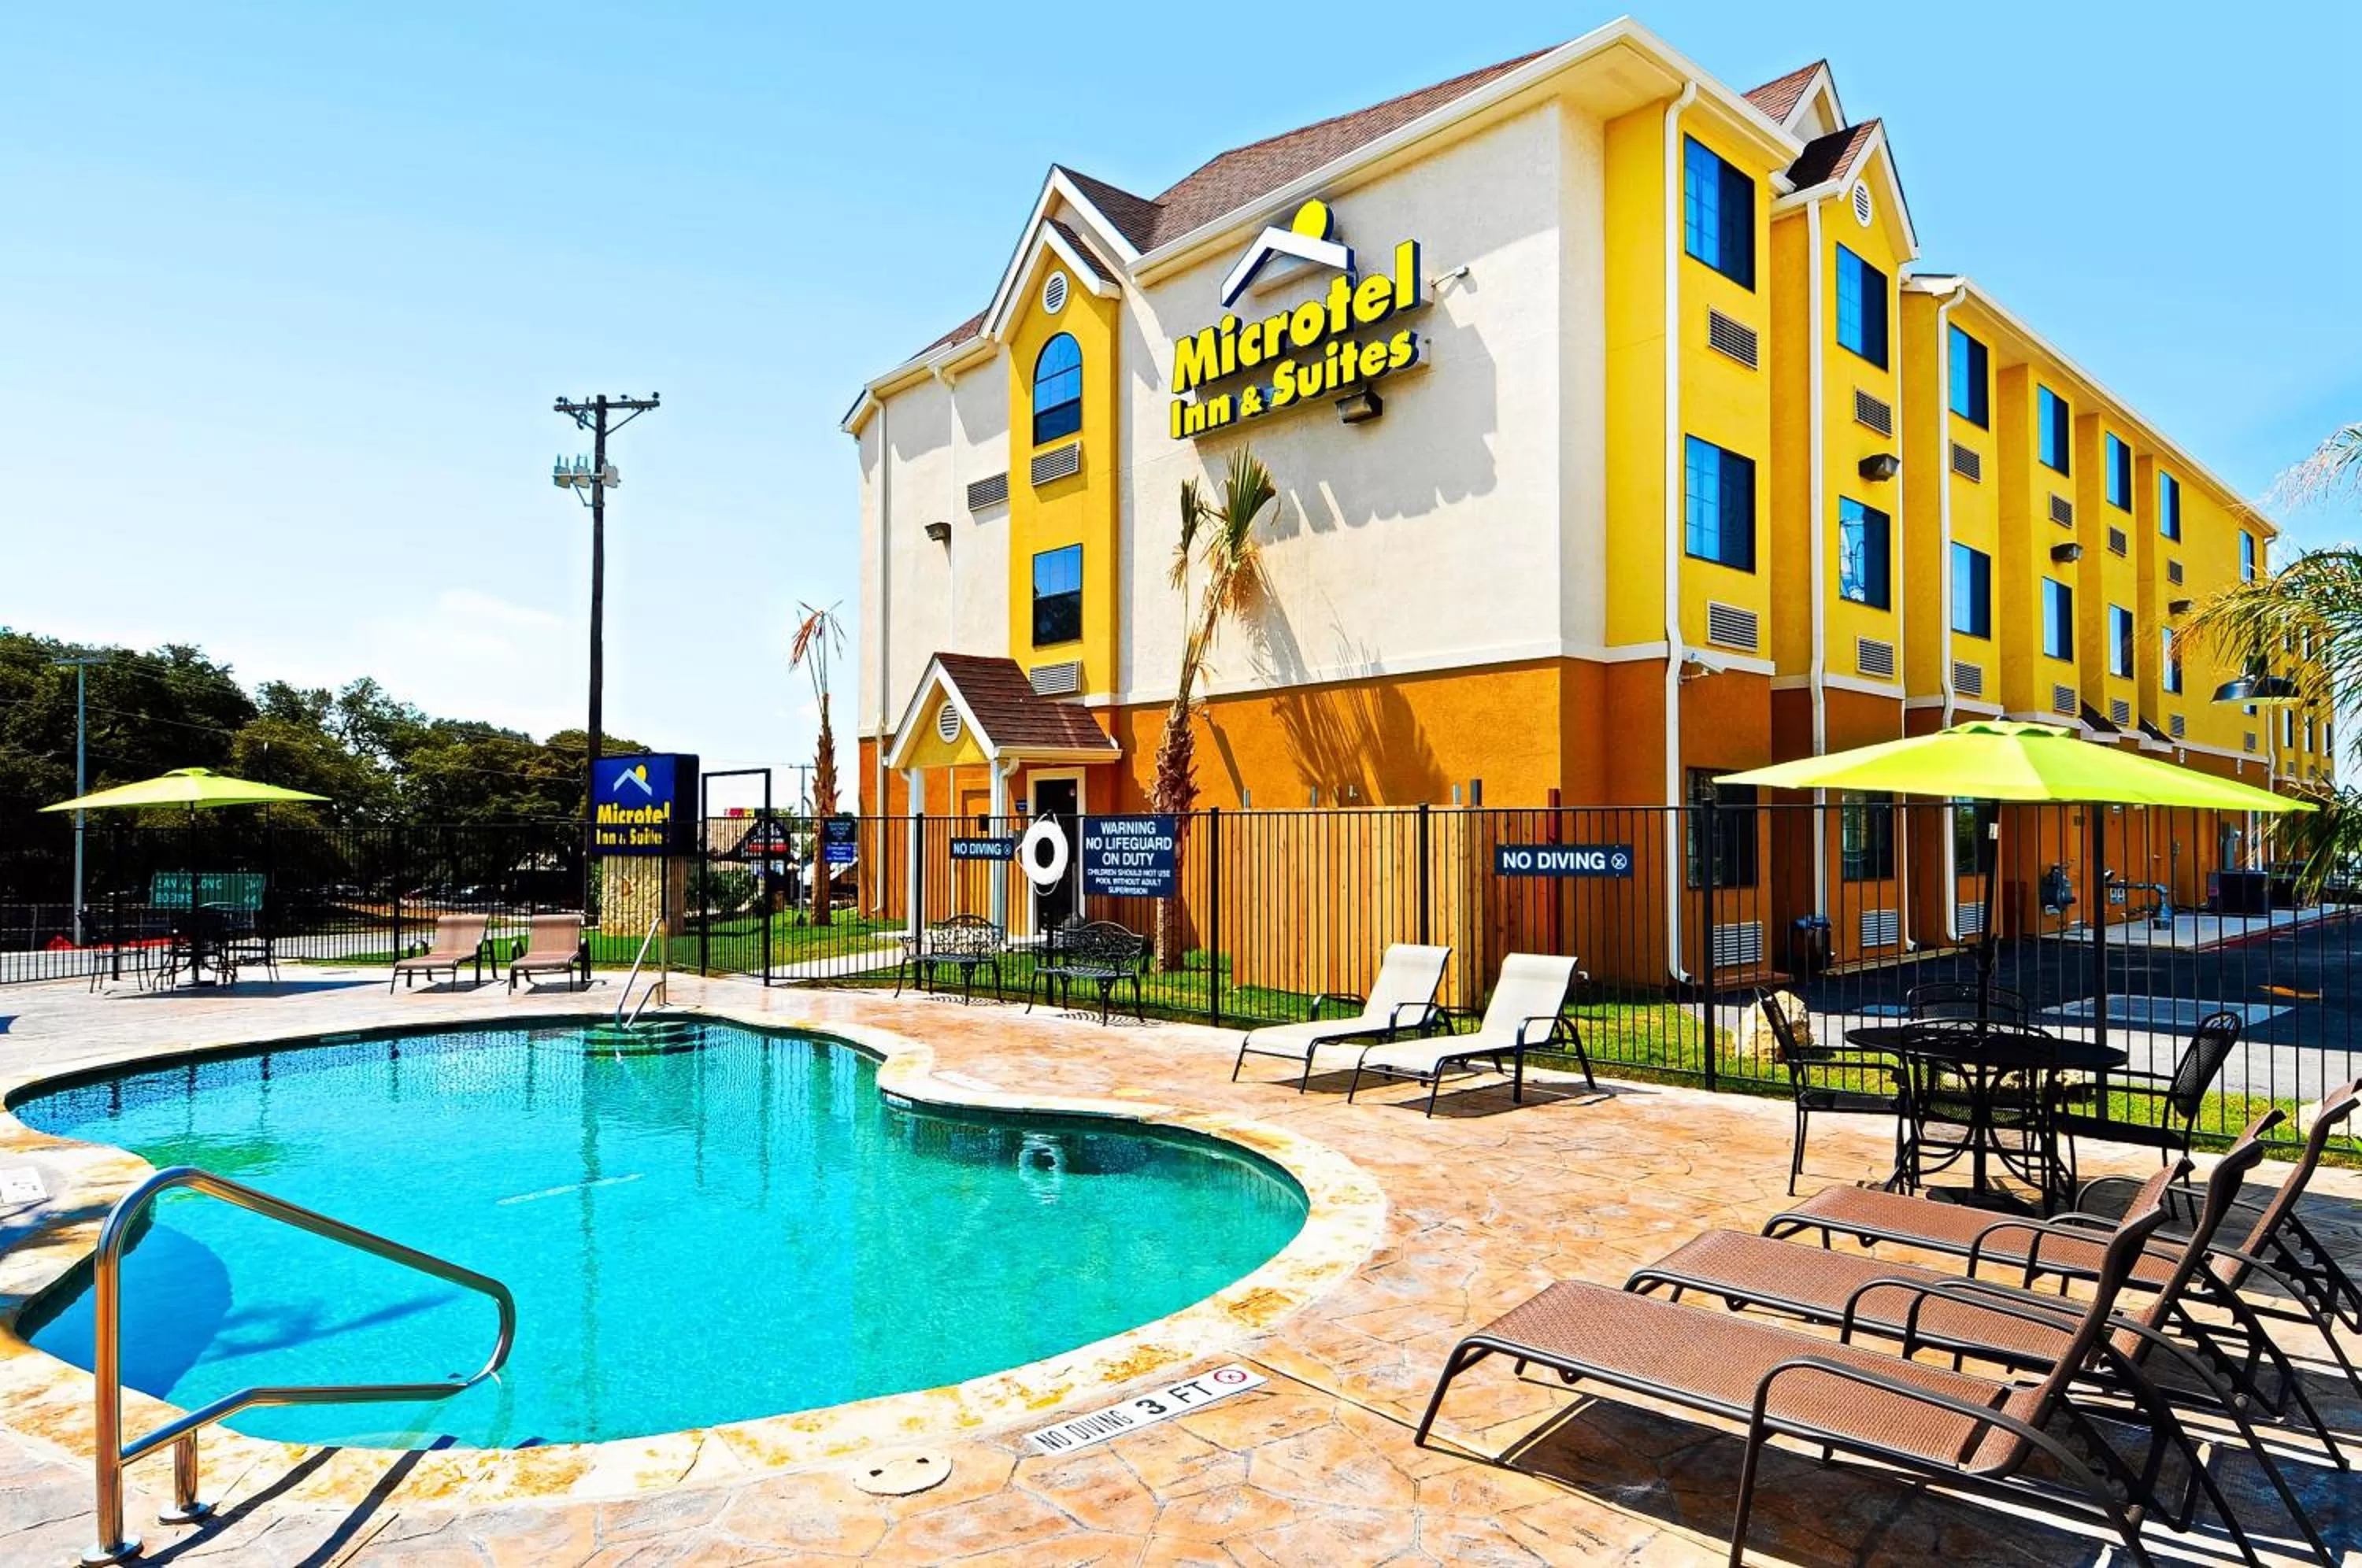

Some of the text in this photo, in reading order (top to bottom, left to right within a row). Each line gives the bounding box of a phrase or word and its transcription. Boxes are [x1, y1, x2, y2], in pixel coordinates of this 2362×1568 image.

[1172, 239, 1420, 394] Microtel
[1171, 329, 1417, 438] Inn & Suites
[596, 801, 670, 825] Microtel
[1100, 821, 1157, 835] WARNING
[596, 828, 616, 845] Inn
[1086, 837, 1172, 850] NO LIFEGUARD
[953, 842, 1001, 856] NO DIVING
[1102, 852, 1155, 866] ON DUTY
[1502, 851, 1605, 870] NO DIVING
[1118, 868, 1142, 877] SHOULD
[1142, 869, 1157, 878] NOT
[1095, 876, 1112, 885] POOL
[1141, 878, 1161, 886] ADULT
[1107, 886, 1148, 895] SUPERVISION
[1035, 1381, 1213, 1450] NO DIVING 3 FT
